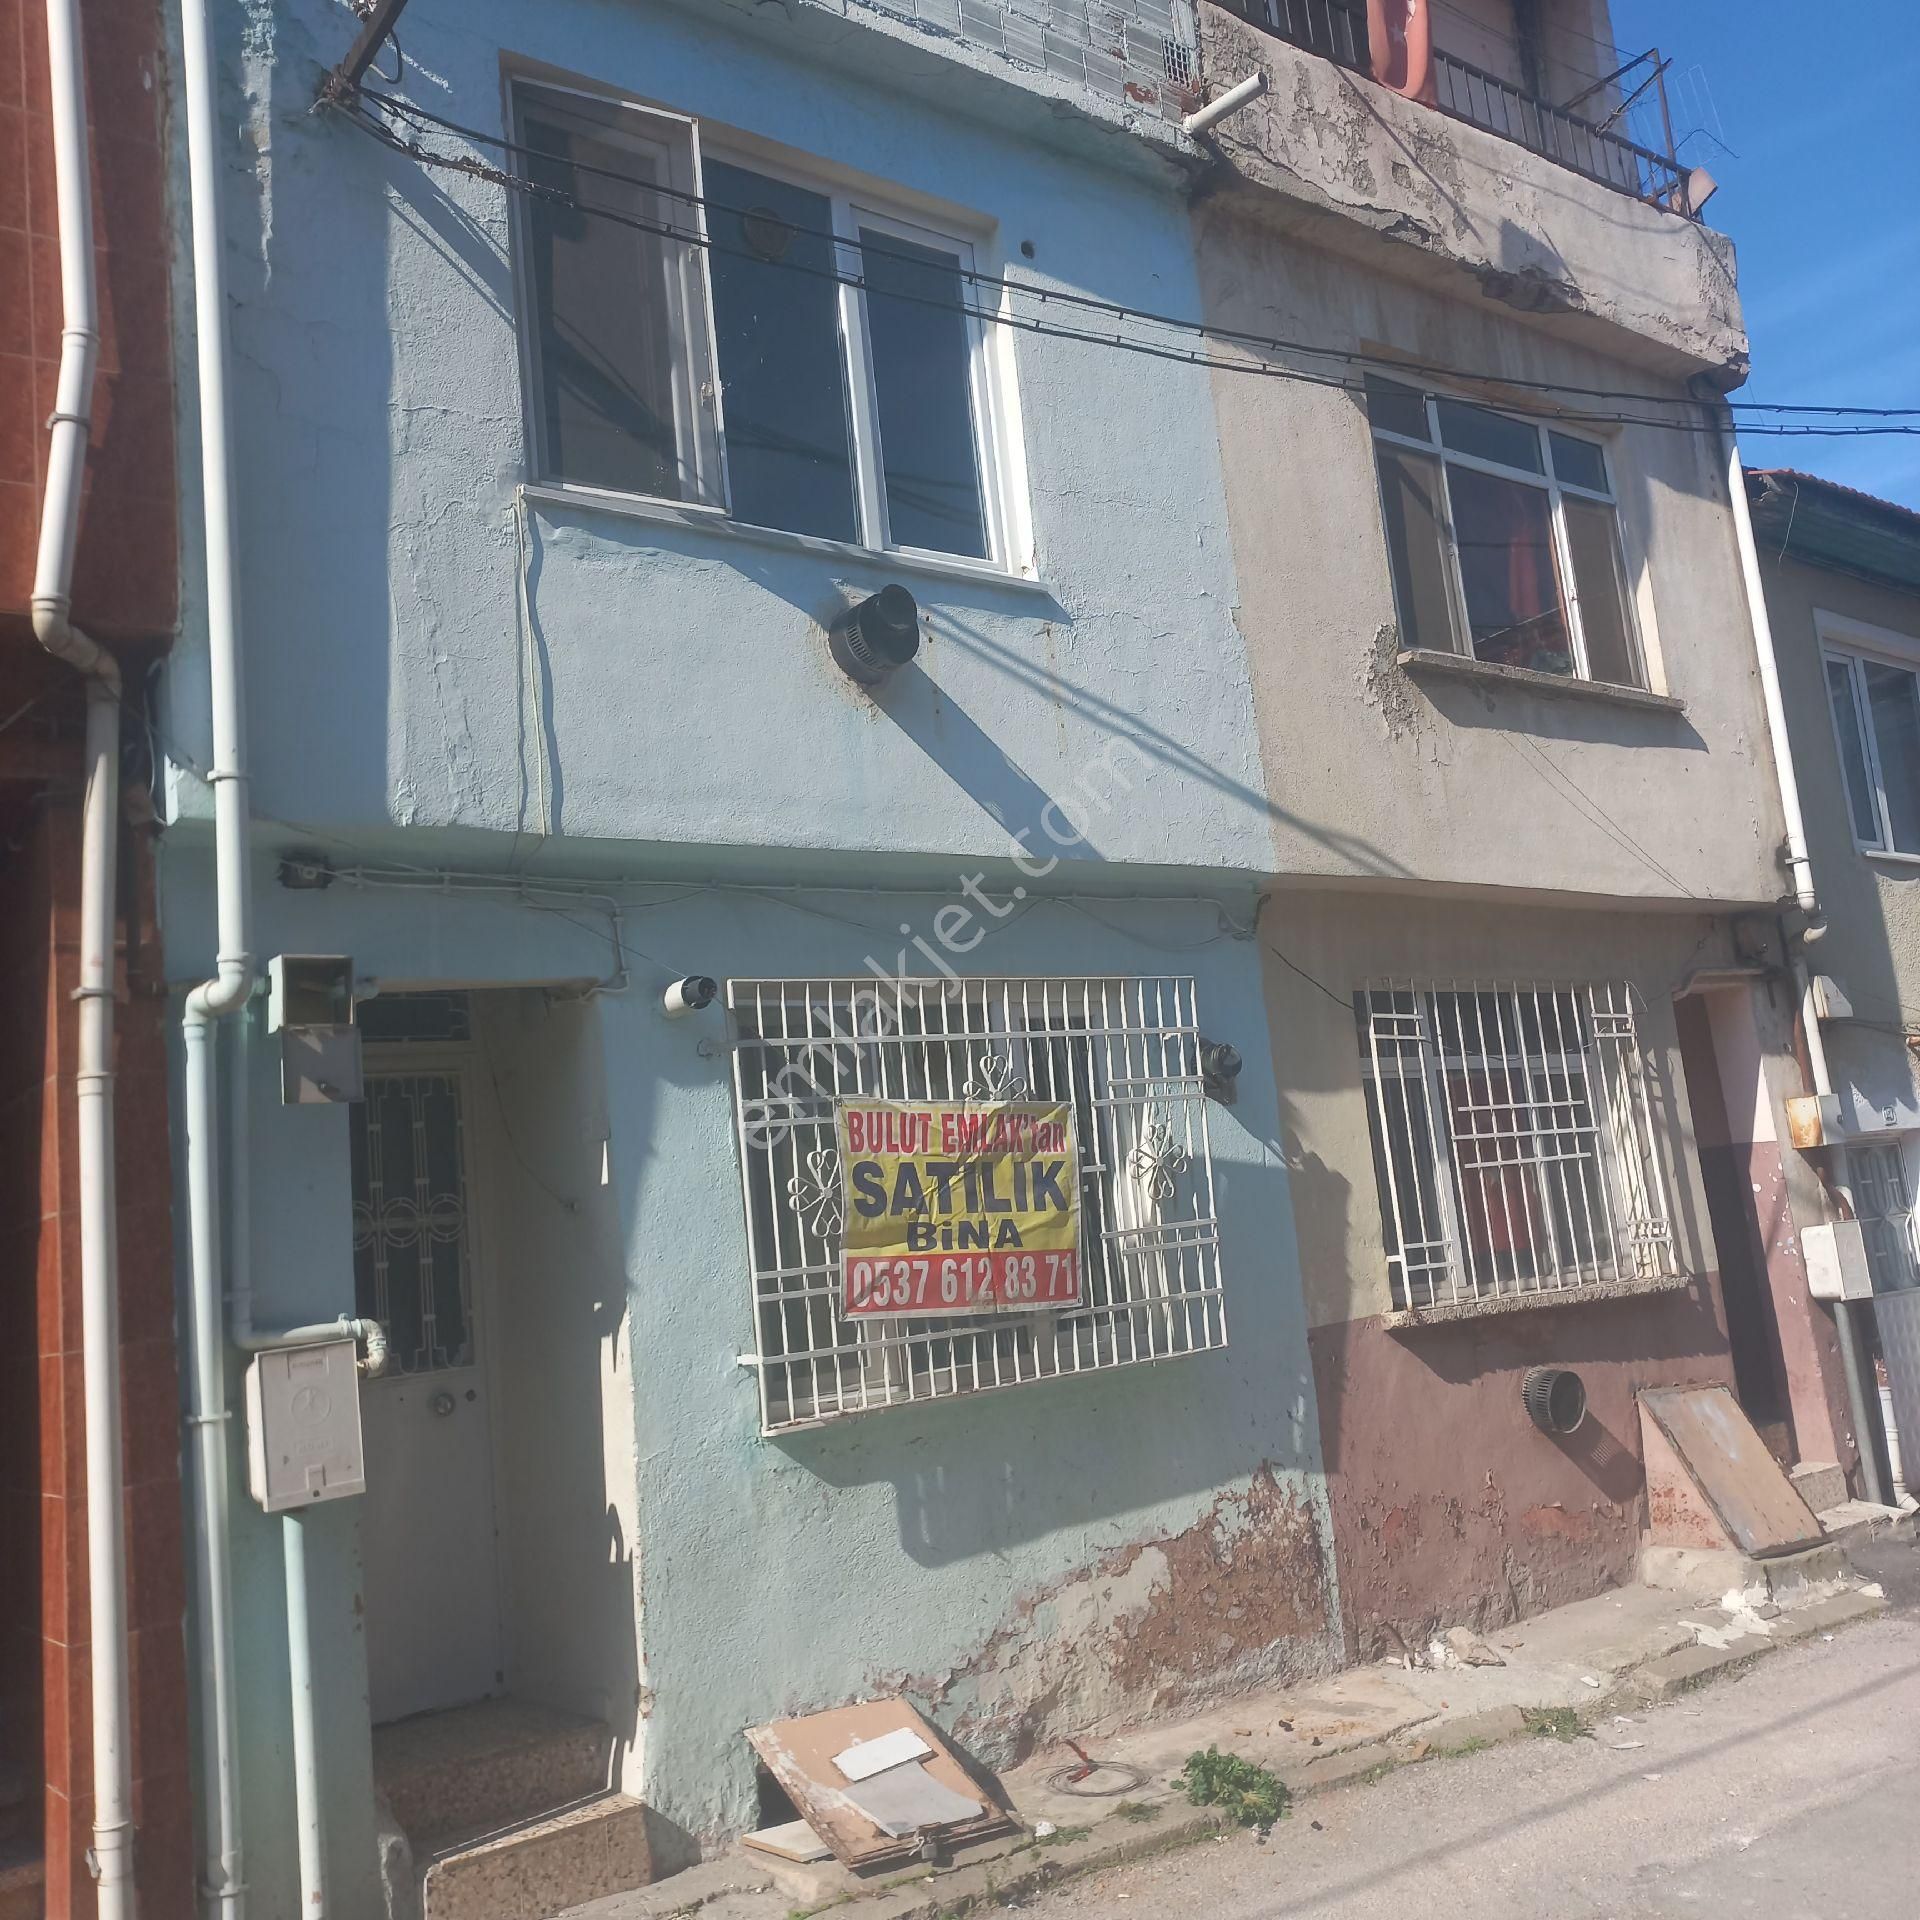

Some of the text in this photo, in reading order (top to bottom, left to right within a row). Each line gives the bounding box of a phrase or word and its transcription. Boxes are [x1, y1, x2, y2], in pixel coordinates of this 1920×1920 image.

[847, 1111, 1065, 1153] BULUT EMLAK'tan
[852, 1161, 1069, 1218] SATILIK
[853, 1252, 1073, 1308] 0537 612 83 71
